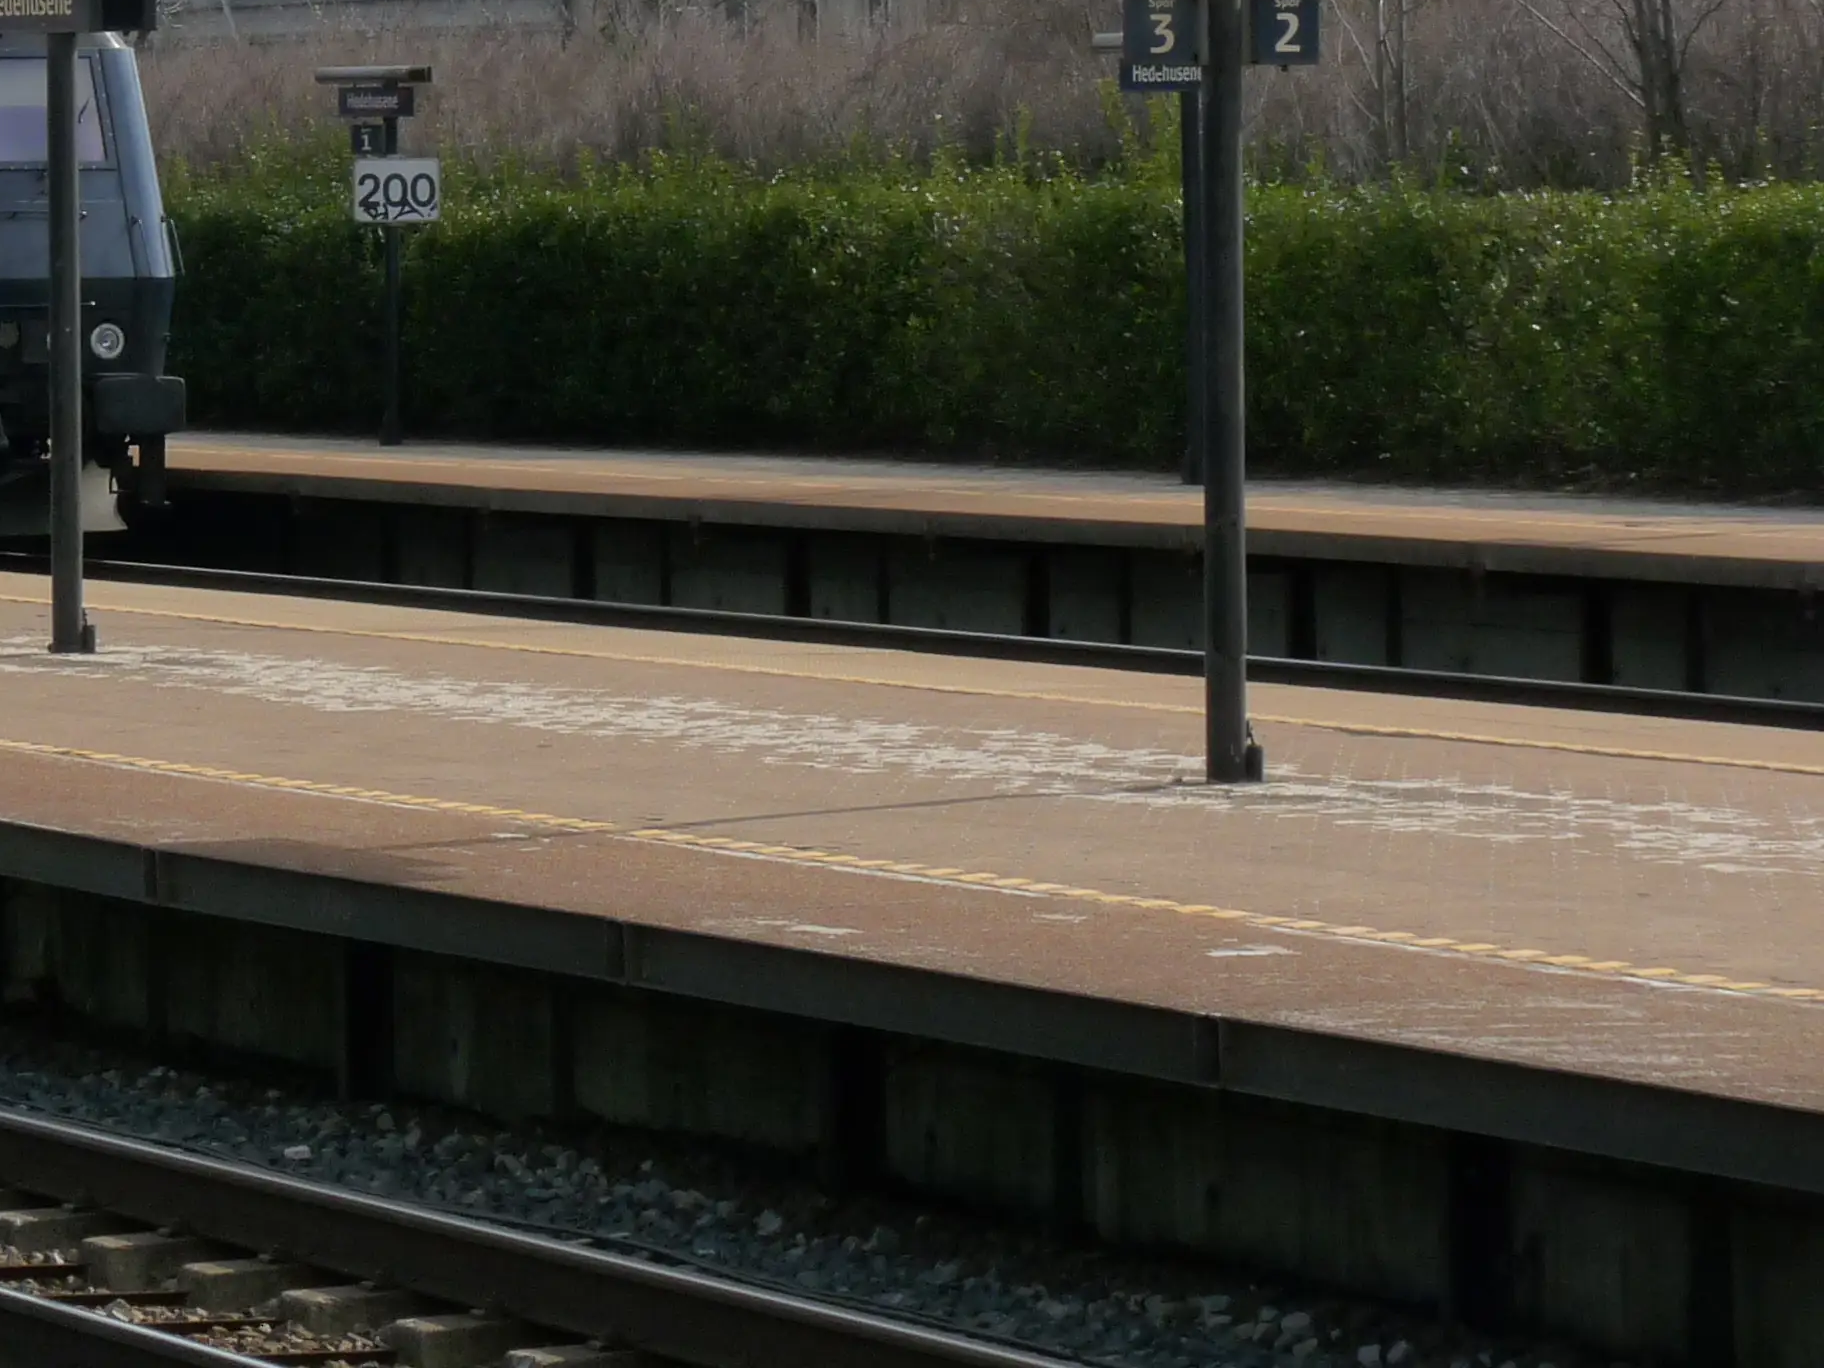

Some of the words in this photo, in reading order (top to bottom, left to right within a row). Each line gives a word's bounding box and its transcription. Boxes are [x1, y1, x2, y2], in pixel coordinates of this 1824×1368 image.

[1150, 13, 1175, 54] 3
[1275, 13, 1301, 53] 2
[361, 134, 372, 151] 1
[358, 173, 436, 208] 200
